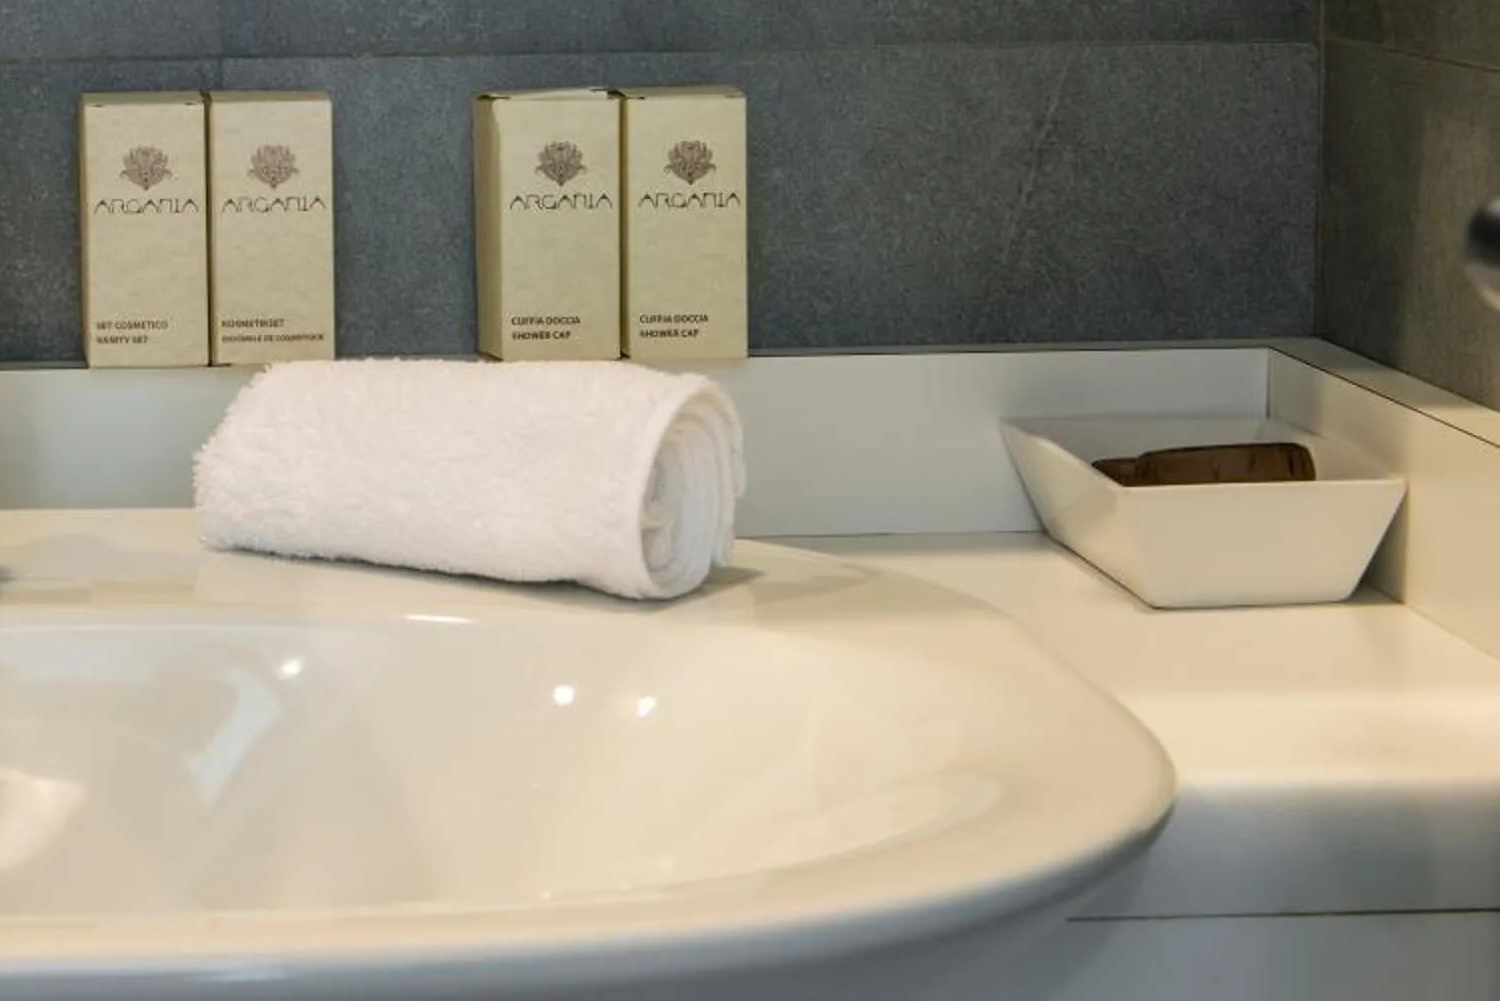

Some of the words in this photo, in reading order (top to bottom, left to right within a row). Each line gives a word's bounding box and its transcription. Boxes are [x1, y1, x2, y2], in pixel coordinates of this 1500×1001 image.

[93, 198, 199, 215] ARGANIA
[221, 195, 327, 213] ARGANIA
[509, 192, 613, 210] ARGANIA
[637, 191, 741, 210] ARGANIA
